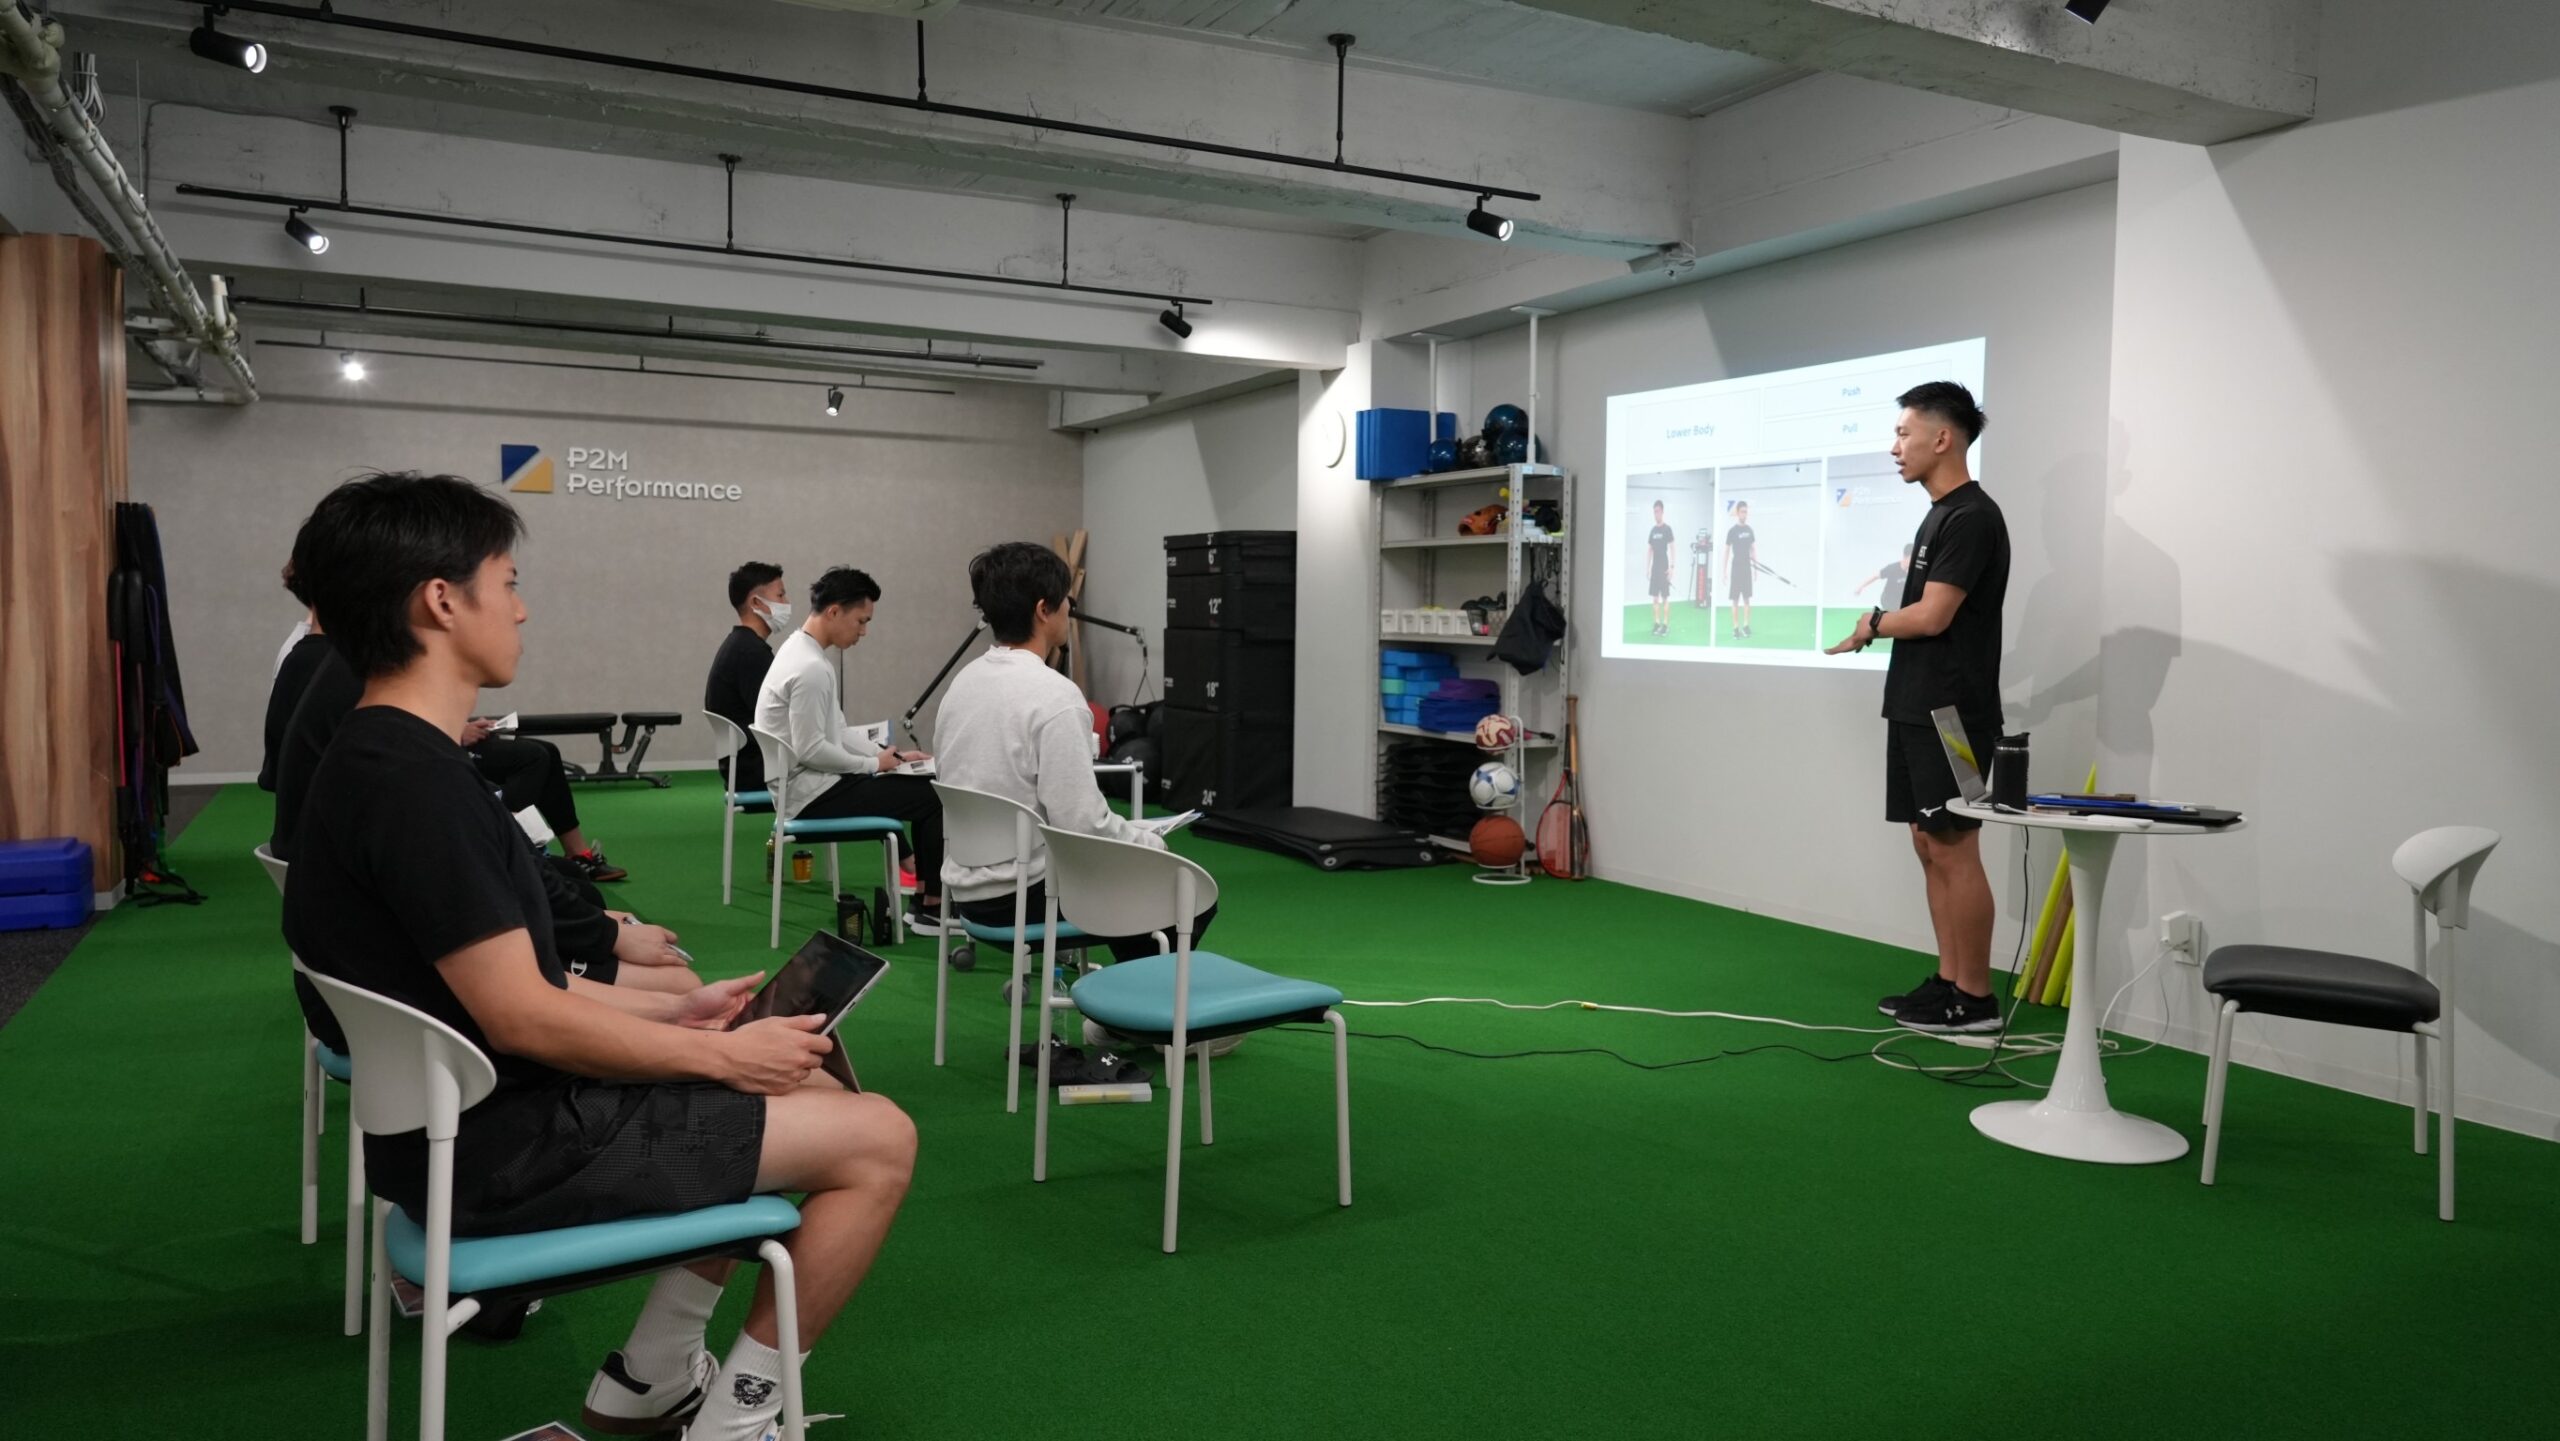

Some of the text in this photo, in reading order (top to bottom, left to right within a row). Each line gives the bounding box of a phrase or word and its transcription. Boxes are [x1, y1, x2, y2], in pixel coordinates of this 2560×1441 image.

[1842, 385, 1861, 397] Push
[1666, 424, 1715, 439] Lower Body
[1842, 423, 1858, 434] Pull
[567, 446, 628, 471] P2M
[567, 472, 743, 500] Performance
